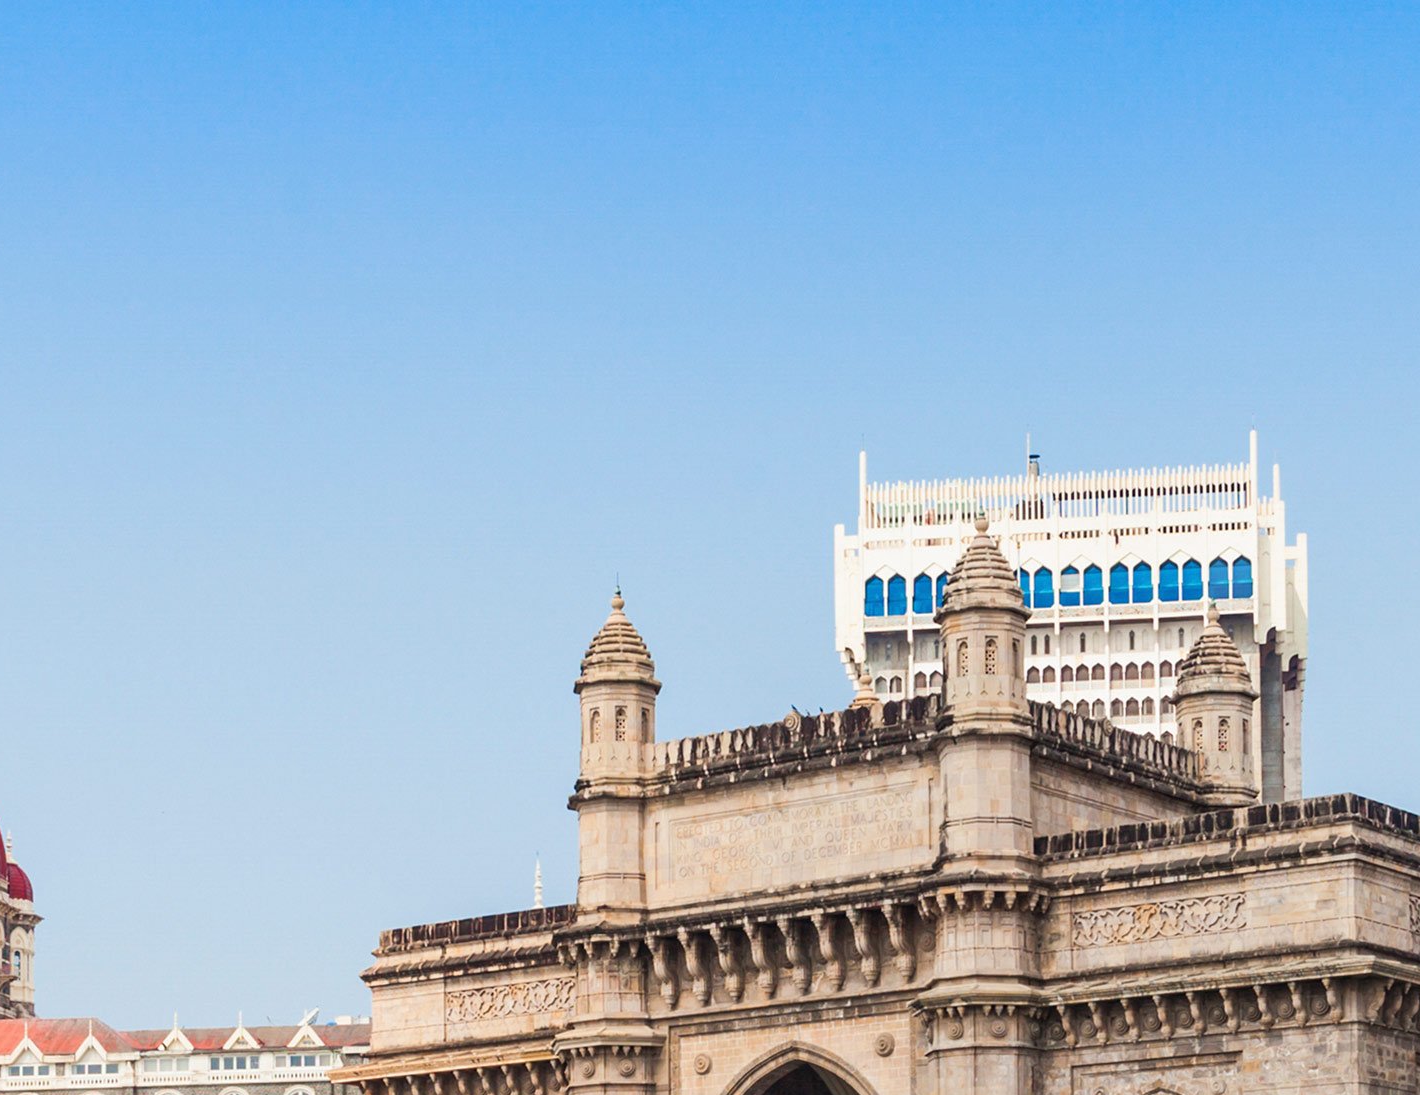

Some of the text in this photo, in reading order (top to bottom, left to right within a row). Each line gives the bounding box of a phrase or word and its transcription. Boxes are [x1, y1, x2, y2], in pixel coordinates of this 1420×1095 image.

[676, 806, 912, 850] IN INDIA OF THEIR IMPERIAL MAJESTIES
[677, 822, 722, 839] ERECTED
[727, 817, 743, 833] TO
[840, 800, 858, 813] THE
[677, 851, 700, 864] KING
[712, 844, 760, 860] GEORGE
[791, 835, 813, 848] AND
[825, 826, 866, 843] QUEEN
[877, 820, 912, 834] MARY
[679, 866, 695, 878] ON
[700, 861, 719, 875] THE
[727, 854, 773, 872] SECOND
[781, 850, 796, 863] OF
[803, 840, 861, 861] DECEMBER
